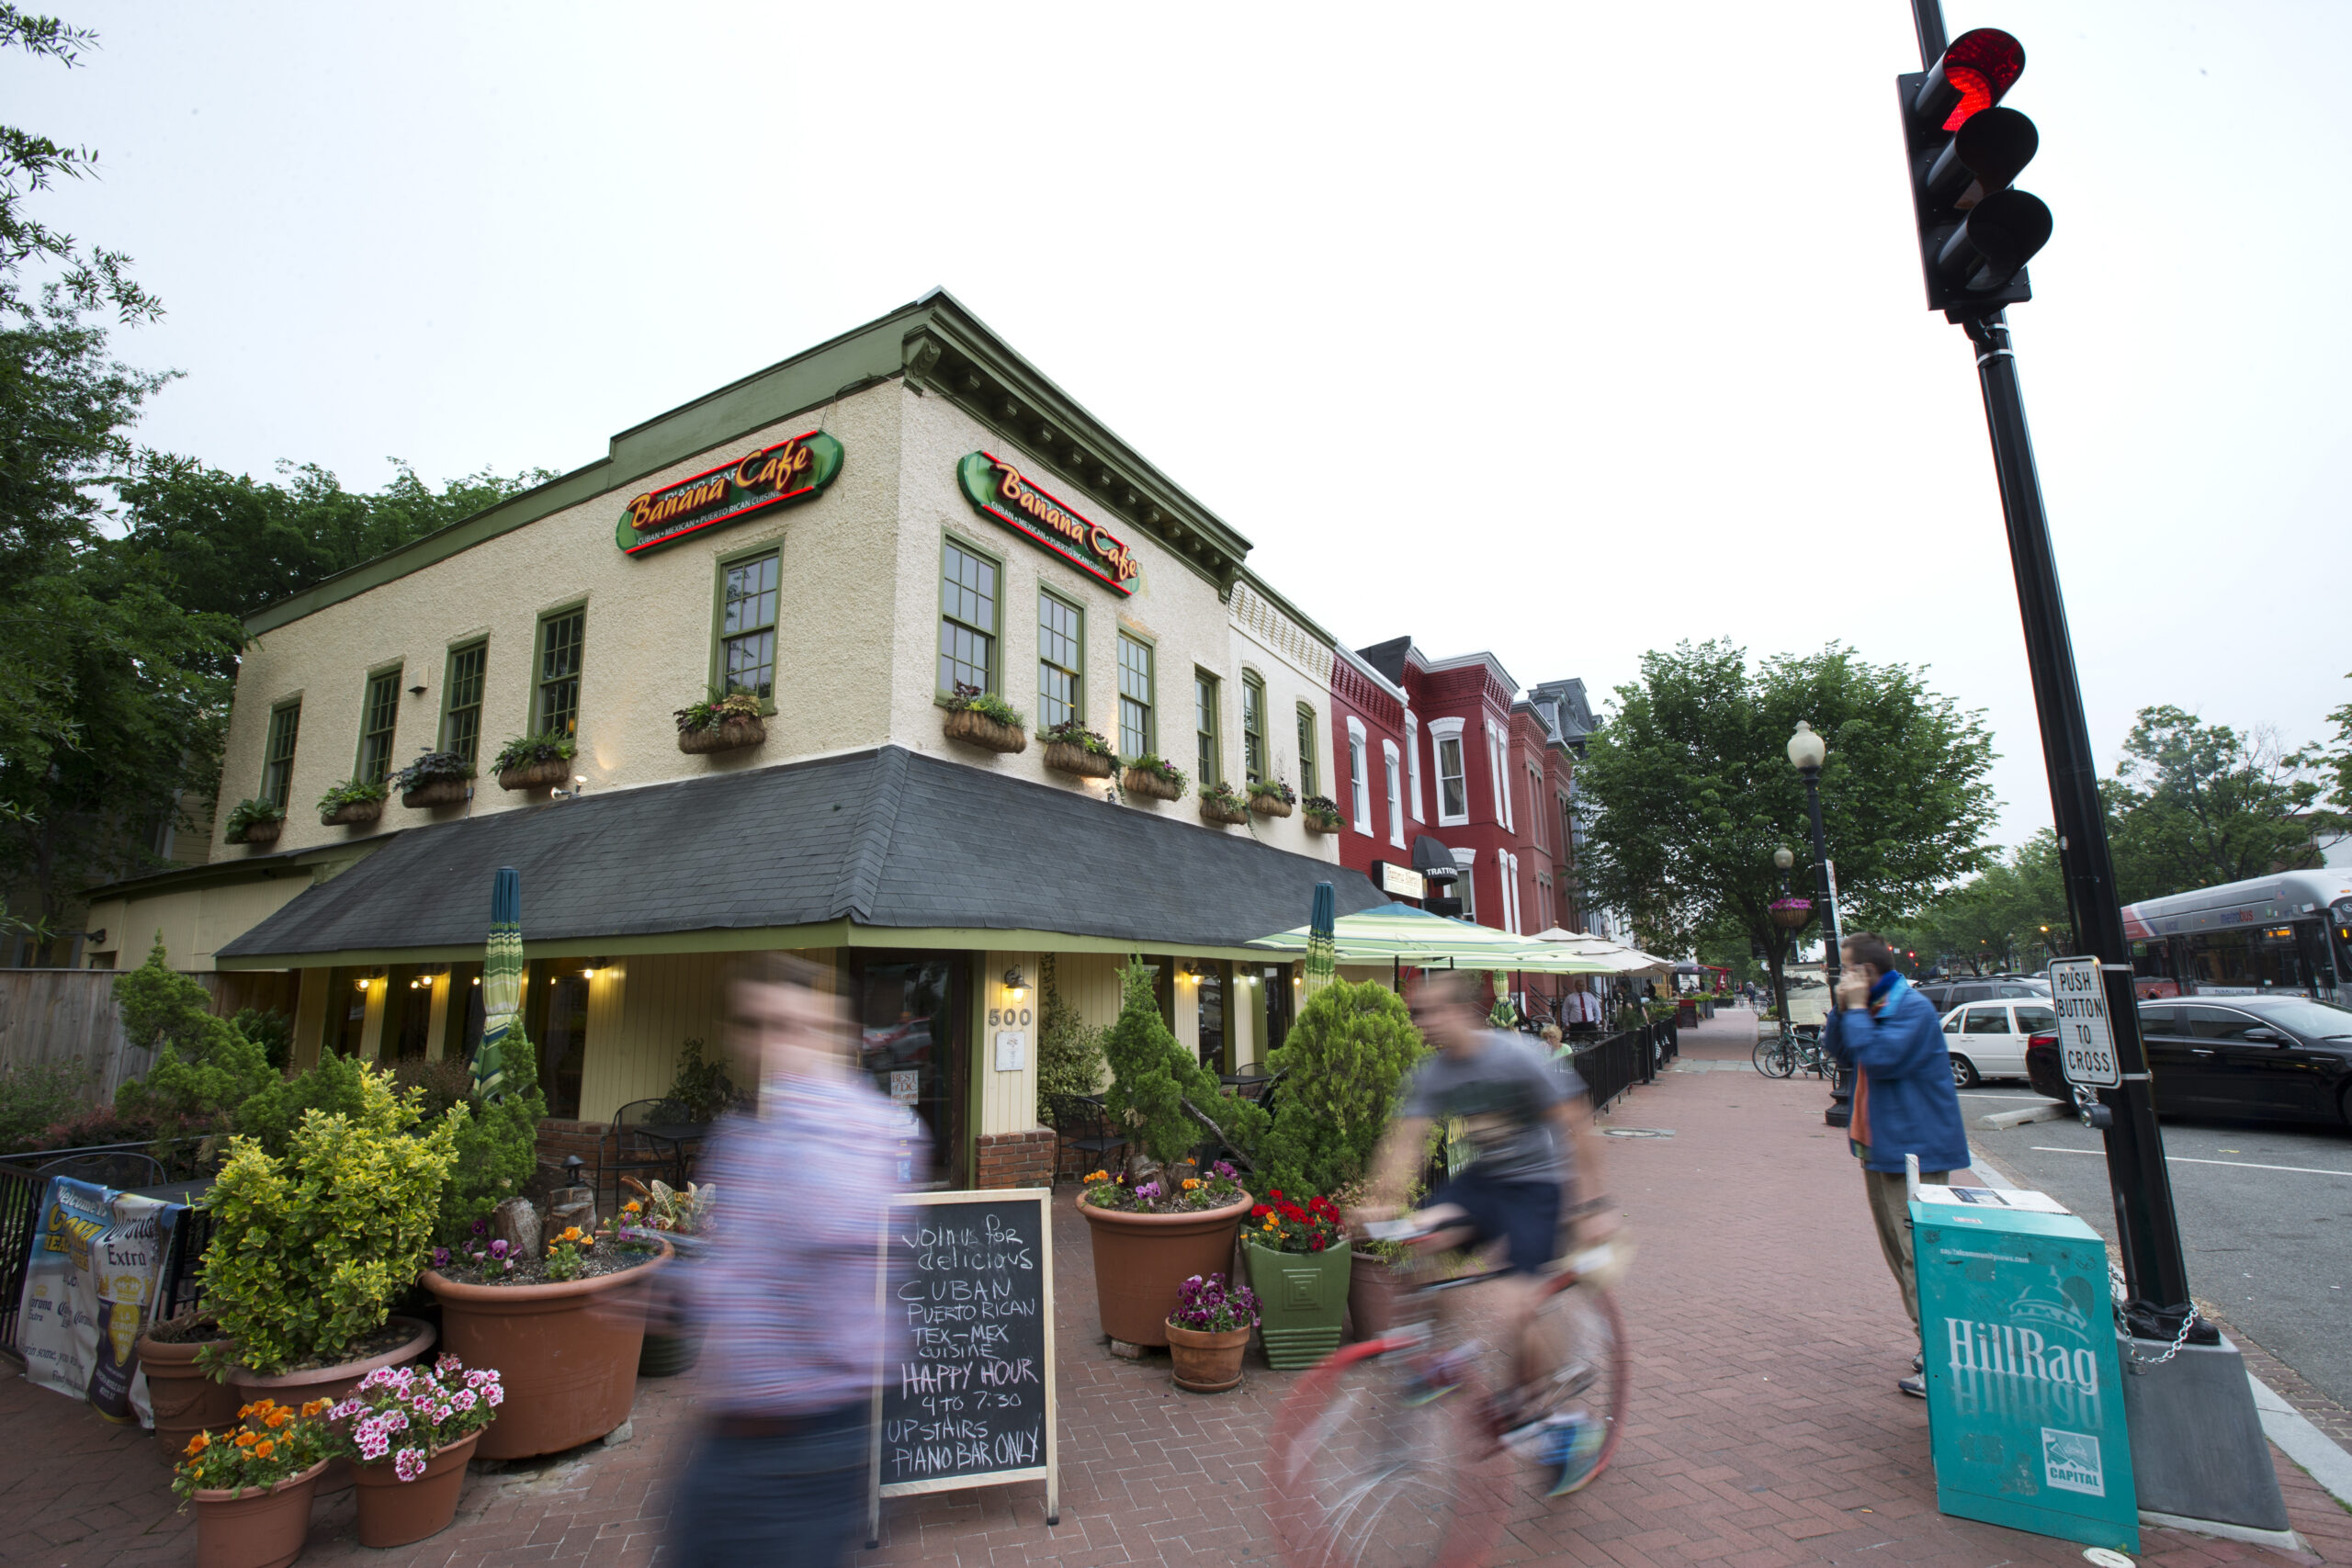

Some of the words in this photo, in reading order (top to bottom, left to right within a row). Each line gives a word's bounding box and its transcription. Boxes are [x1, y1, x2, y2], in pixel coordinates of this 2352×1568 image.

[627, 478, 732, 532] Banana
[990, 462, 1085, 546] Banana
[638, 532, 660, 546] CUBAN
[665, 520, 695, 536] MEXICAN
[699, 508, 729, 524] PUERTO
[729, 500, 752, 513] RICAN
[751, 491, 780, 505] CUISINE
[991, 501, 1014, 521] CUBAN
[1018, 517, 1046, 540] MEXICAN
[1050, 536, 1073, 557] PUERTO
[1072, 548, 1090, 567] RICAN
[1090, 560, 1110, 578] CUISINE
[2059, 972, 2091, 991] PUSH
[989, 1009, 1032, 1026] 500
[2057, 998, 2103, 1018] BUTTON
[2075, 1024, 2091, 1044] TO
[2068, 1050, 2109, 1072] CROSS
[892, 1072, 916, 1082] BEST
[57, 1186, 98, 1214] Welcome
[901, 1216, 956, 1249] Join
[104, 1242, 147, 1267] Extra
[898, 1278, 1012, 1302] CUBAN
[907, 1303, 977, 1325] PUERTO
[911, 1324, 1010, 1347] TEX-MEX
[901, 1361, 973, 1400] HAPPY
[980, 1359, 1039, 1386] HOUR
[922, 1396, 936, 1416] 4
[940, 1395, 964, 1412] TO
[973, 1391, 1022, 1411] 7:30
[888, 1412, 989, 1443] UPSTAIRS
[891, 1446, 953, 1478] PIANO
[956, 1439, 993, 1469] BAR
[994, 1426, 1039, 1466] ONLY
[2050, 1467, 2099, 1486] CAPITAL
